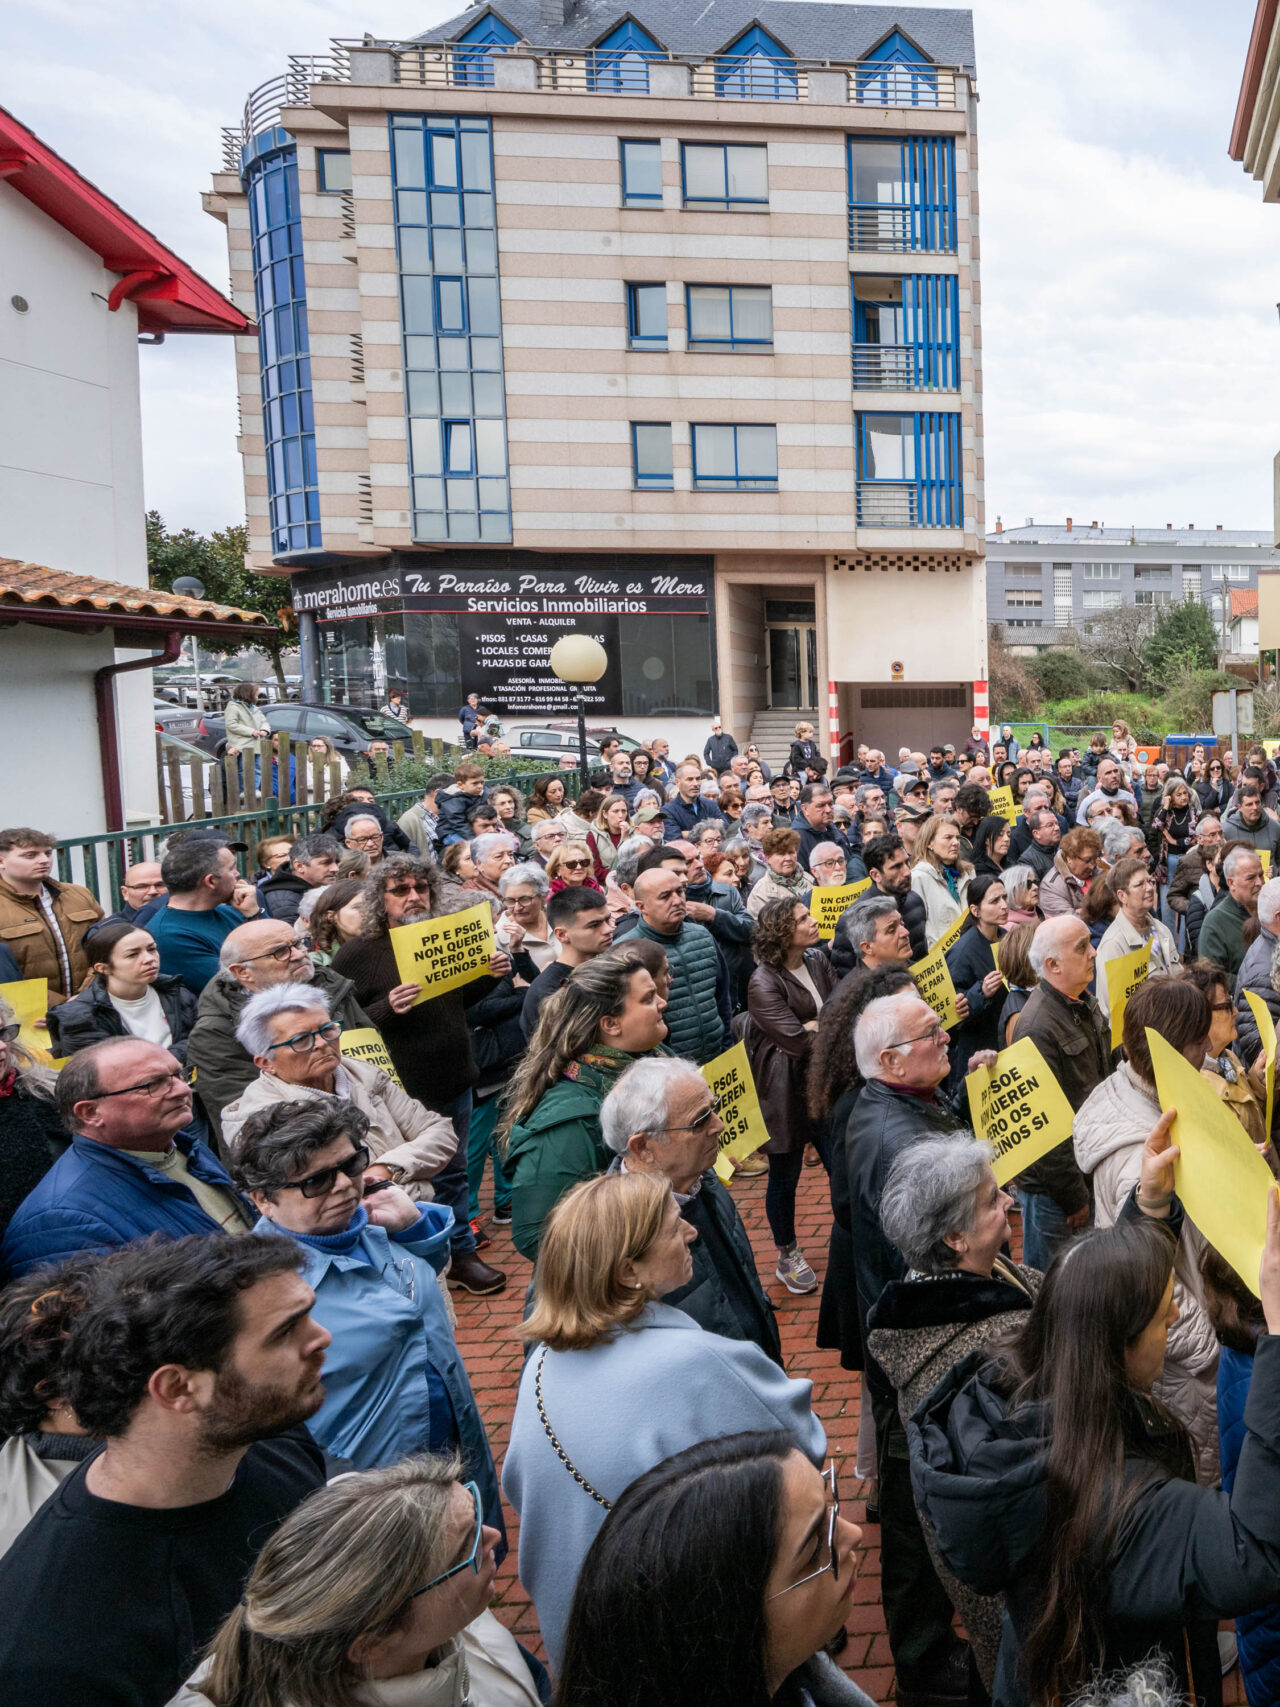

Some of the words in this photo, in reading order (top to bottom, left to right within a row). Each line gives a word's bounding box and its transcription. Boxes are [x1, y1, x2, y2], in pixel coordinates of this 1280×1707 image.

[304, 578, 400, 608] merahome.es
[405, 574, 431, 593] Tu
[438, 574, 511, 594] Paraíso
[519, 575, 567, 594] Para
[574, 575, 620, 594] Vivir
[626, 582, 644, 594] es
[651, 576, 706, 594] Mera
[326, 606, 347, 620] Servicios
[347, 602, 378, 616] Inmobiliarios
[468, 597, 538, 612] Servicios
[543, 598, 647, 612] Inmobiliarios
[506, 618, 532, 626] VENTA
[539, 618, 576, 627] ALQUILER
[481, 634, 506, 643] PISOS
[520, 634, 548, 643] CASAS
[482, 646, 519, 655] LOCALES
[482, 659, 514, 668] PLAZAS
[516, 659, 527, 668] DE
[422, 934, 439, 946] PP
[443, 930, 451, 940] E
[455, 920, 482, 937] PSOE
[414, 945, 443, 962] NON
[447, 929, 490, 952] QUEREN
[432, 952, 464, 970] PERO
[468, 945, 483, 957] OS
[425, 959, 477, 984] VECIÑOS
[480, 954, 490, 965] SI
[916, 965, 936, 984] ENTRO
[935, 959, 944, 971] DE
[928, 973, 945, 990] PARA
[341, 1043, 381, 1057] ENTRO
[713, 1068, 738, 1094] PSOE
[726, 1105, 739, 1123] OS
[1010, 1102, 1031, 1123] OS
[1032, 1112, 1049, 1130] SI
[738, 1117, 749, 1134] SI
